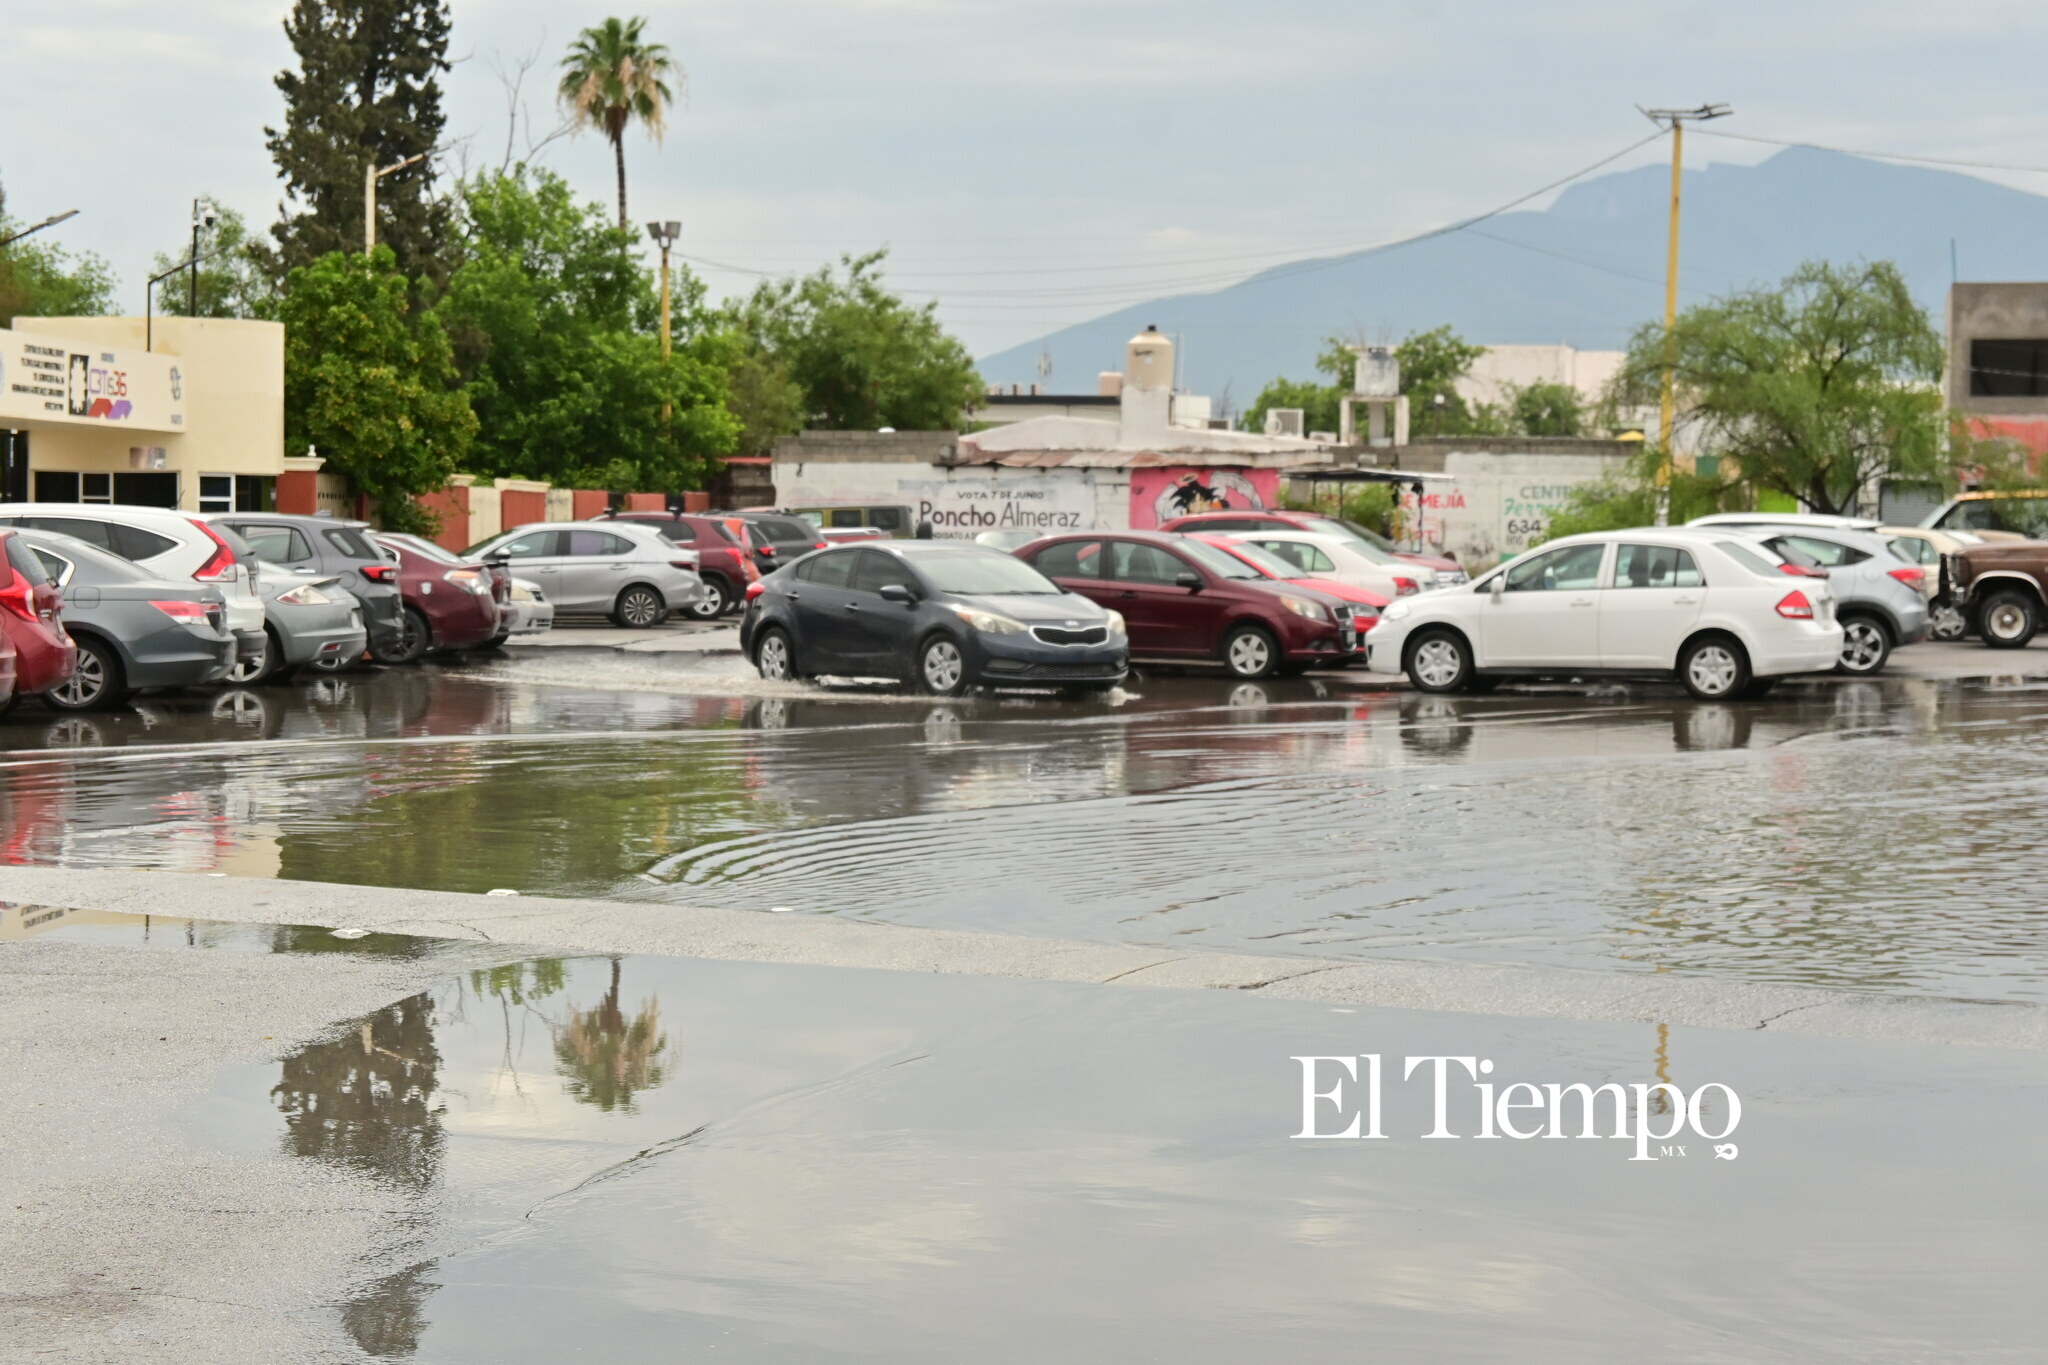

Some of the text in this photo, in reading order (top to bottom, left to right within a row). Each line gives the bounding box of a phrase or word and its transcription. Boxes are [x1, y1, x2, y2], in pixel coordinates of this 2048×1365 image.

[957, 491, 988, 500] VOTA
[1000, 491, 1011, 499] DE
[1013, 491, 1044, 500] JUNIO
[1520, 485, 1572, 499] CENTR
[920, 501, 1080, 528] Poncho Almeraz
[1507, 519, 1541, 534] 634
